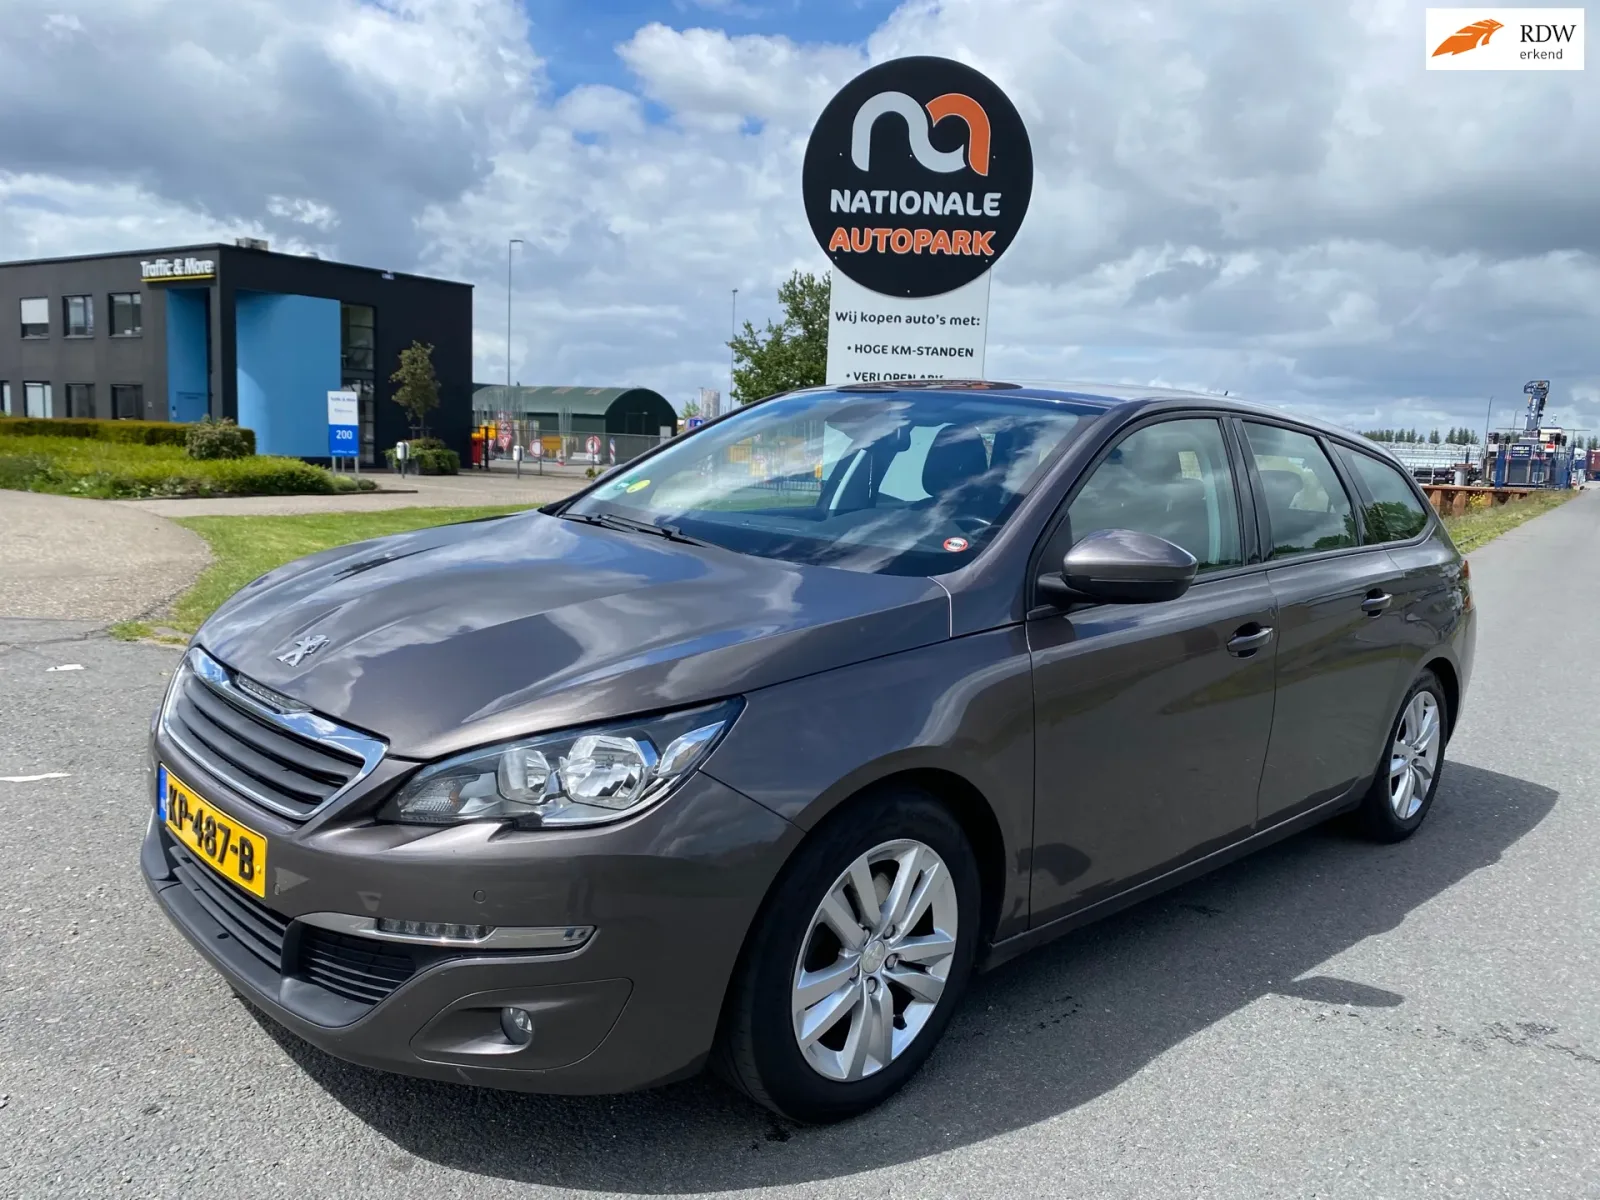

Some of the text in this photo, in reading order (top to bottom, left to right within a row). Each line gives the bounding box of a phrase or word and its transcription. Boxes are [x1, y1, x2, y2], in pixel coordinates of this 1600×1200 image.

[830, 189, 1001, 216] NATIONALE
[828, 226, 996, 256] AUTOPARK
[140, 257, 215, 277] Traffic & More
[835, 311, 980, 326] Wij kopen auto's met:
[854, 344, 974, 358] HOGE KM-STANDEN
[335, 429, 353, 440] 200
[167, 784, 255, 882] KP-487-B
